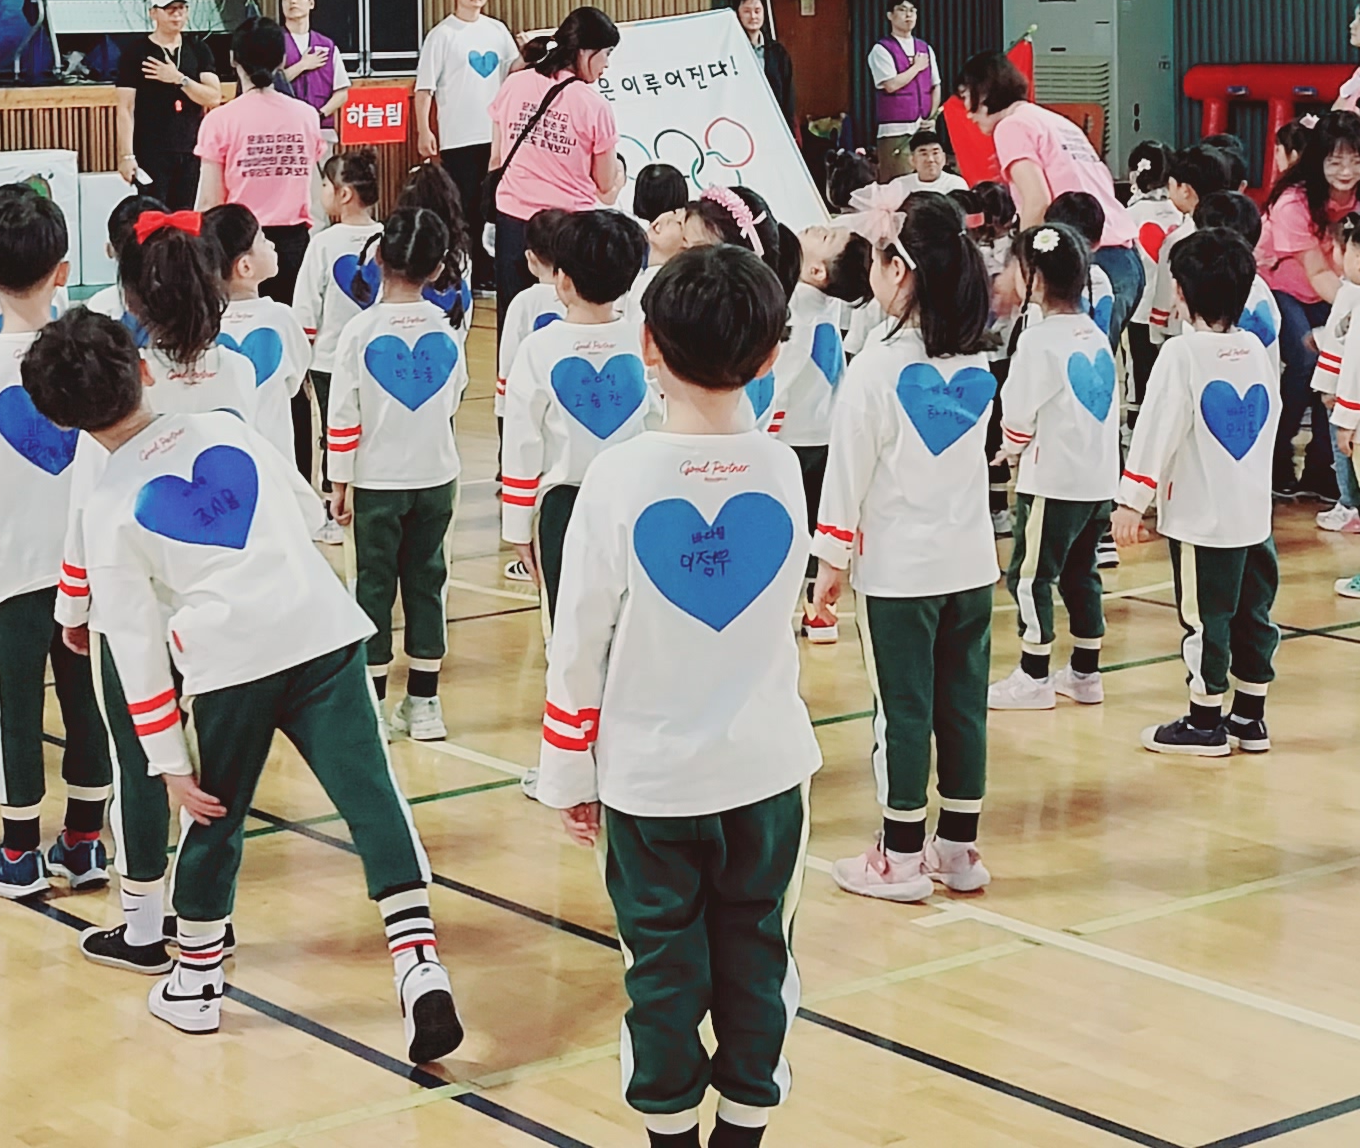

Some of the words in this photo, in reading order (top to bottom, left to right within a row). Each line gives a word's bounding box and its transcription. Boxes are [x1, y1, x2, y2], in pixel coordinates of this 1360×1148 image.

[621, 55, 739, 96] 이루어진다!
[345, 101, 403, 129] 하늘팀
[680, 460, 710, 475] Good
[711, 460, 750, 475] Partner
